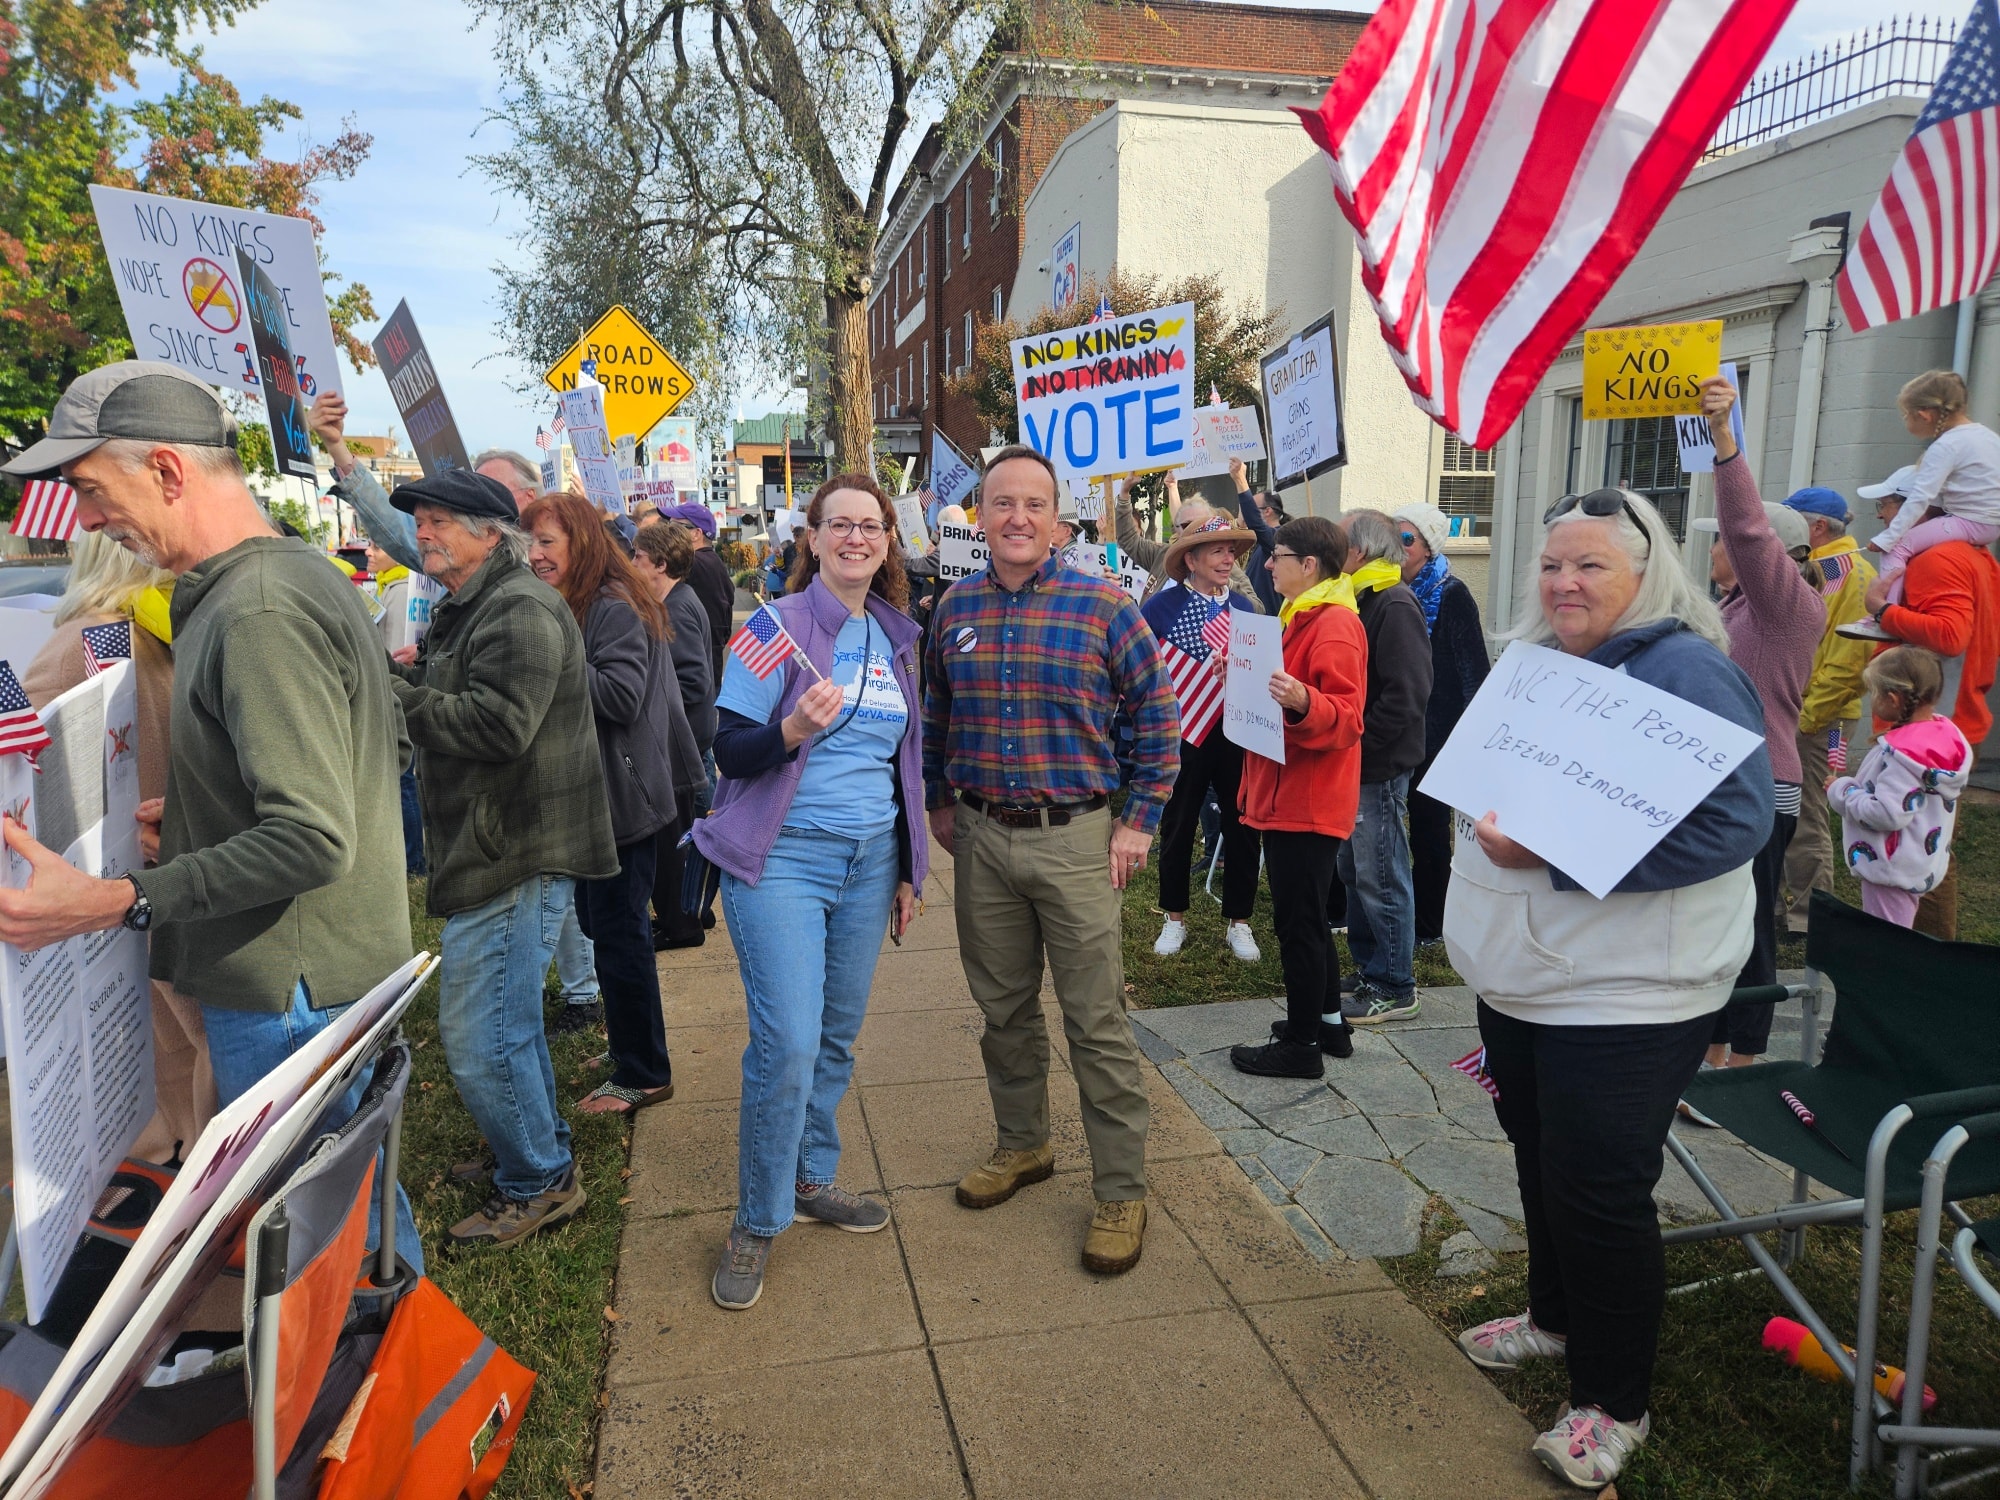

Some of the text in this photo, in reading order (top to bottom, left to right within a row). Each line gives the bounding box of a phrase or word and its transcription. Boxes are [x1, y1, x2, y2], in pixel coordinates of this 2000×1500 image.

[134, 203, 275, 265] NO KINGS
[118, 256, 170, 299] NOPE
[149, 322, 229, 375] SINCE
[234, 342, 317, 397] 16
[588, 344, 653, 366] ROAD
[1022, 318, 1158, 370] NO KINGS
[1617, 348, 1670, 375] NO
[389, 348, 436, 414] BETRAYS
[562, 372, 680, 396] NRROWS
[1026, 344, 1176, 399] NO TYRANNY
[1605, 374, 1700, 402] KINGS
[1024, 384, 1184, 469] VOTE
[1679, 416, 1716, 450] KIN
[936, 463, 969, 497] DEMS
[942, 525, 986, 543] BRING
[971, 548, 992, 560] OU
[418, 598, 430, 623] THE
[1234, 628, 1257, 646] KINGS
[1246, 711, 1282, 739] DEMOCRACY!
[1560, 676, 1629, 720] THE
[1632, 708, 1728, 773] PEOPLE
[1483, 722, 1680, 828] DEFEND DEMOCRACY
[88, 980, 117, 1018] Section.
[28, 1053, 57, 1099] Section.
